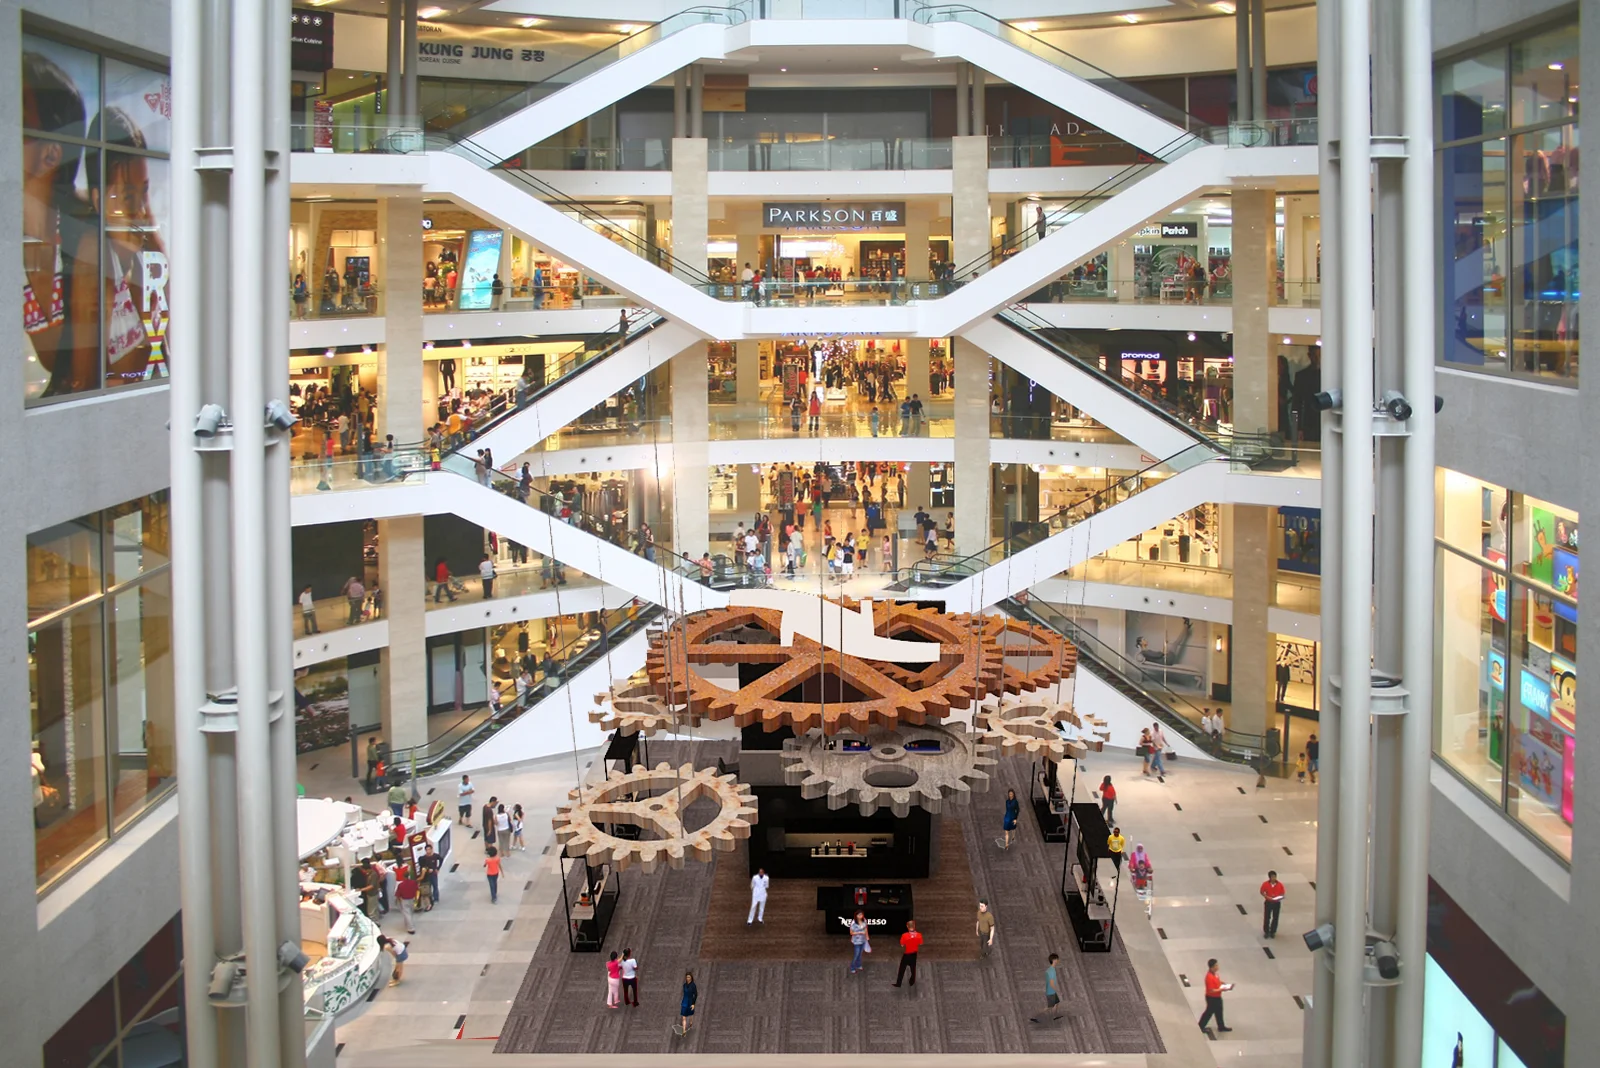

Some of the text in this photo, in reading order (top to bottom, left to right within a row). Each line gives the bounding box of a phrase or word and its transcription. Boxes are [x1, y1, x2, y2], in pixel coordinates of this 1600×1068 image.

[417, 25, 442, 33] STORAN
[303, 37, 323, 45] Cuisine
[418, 42, 463, 57] KUNG
[471, 46, 514, 60] JUNG
[769, 208, 898, 222] PARKSON 百盛
[1162, 226, 1189, 236] Patch
